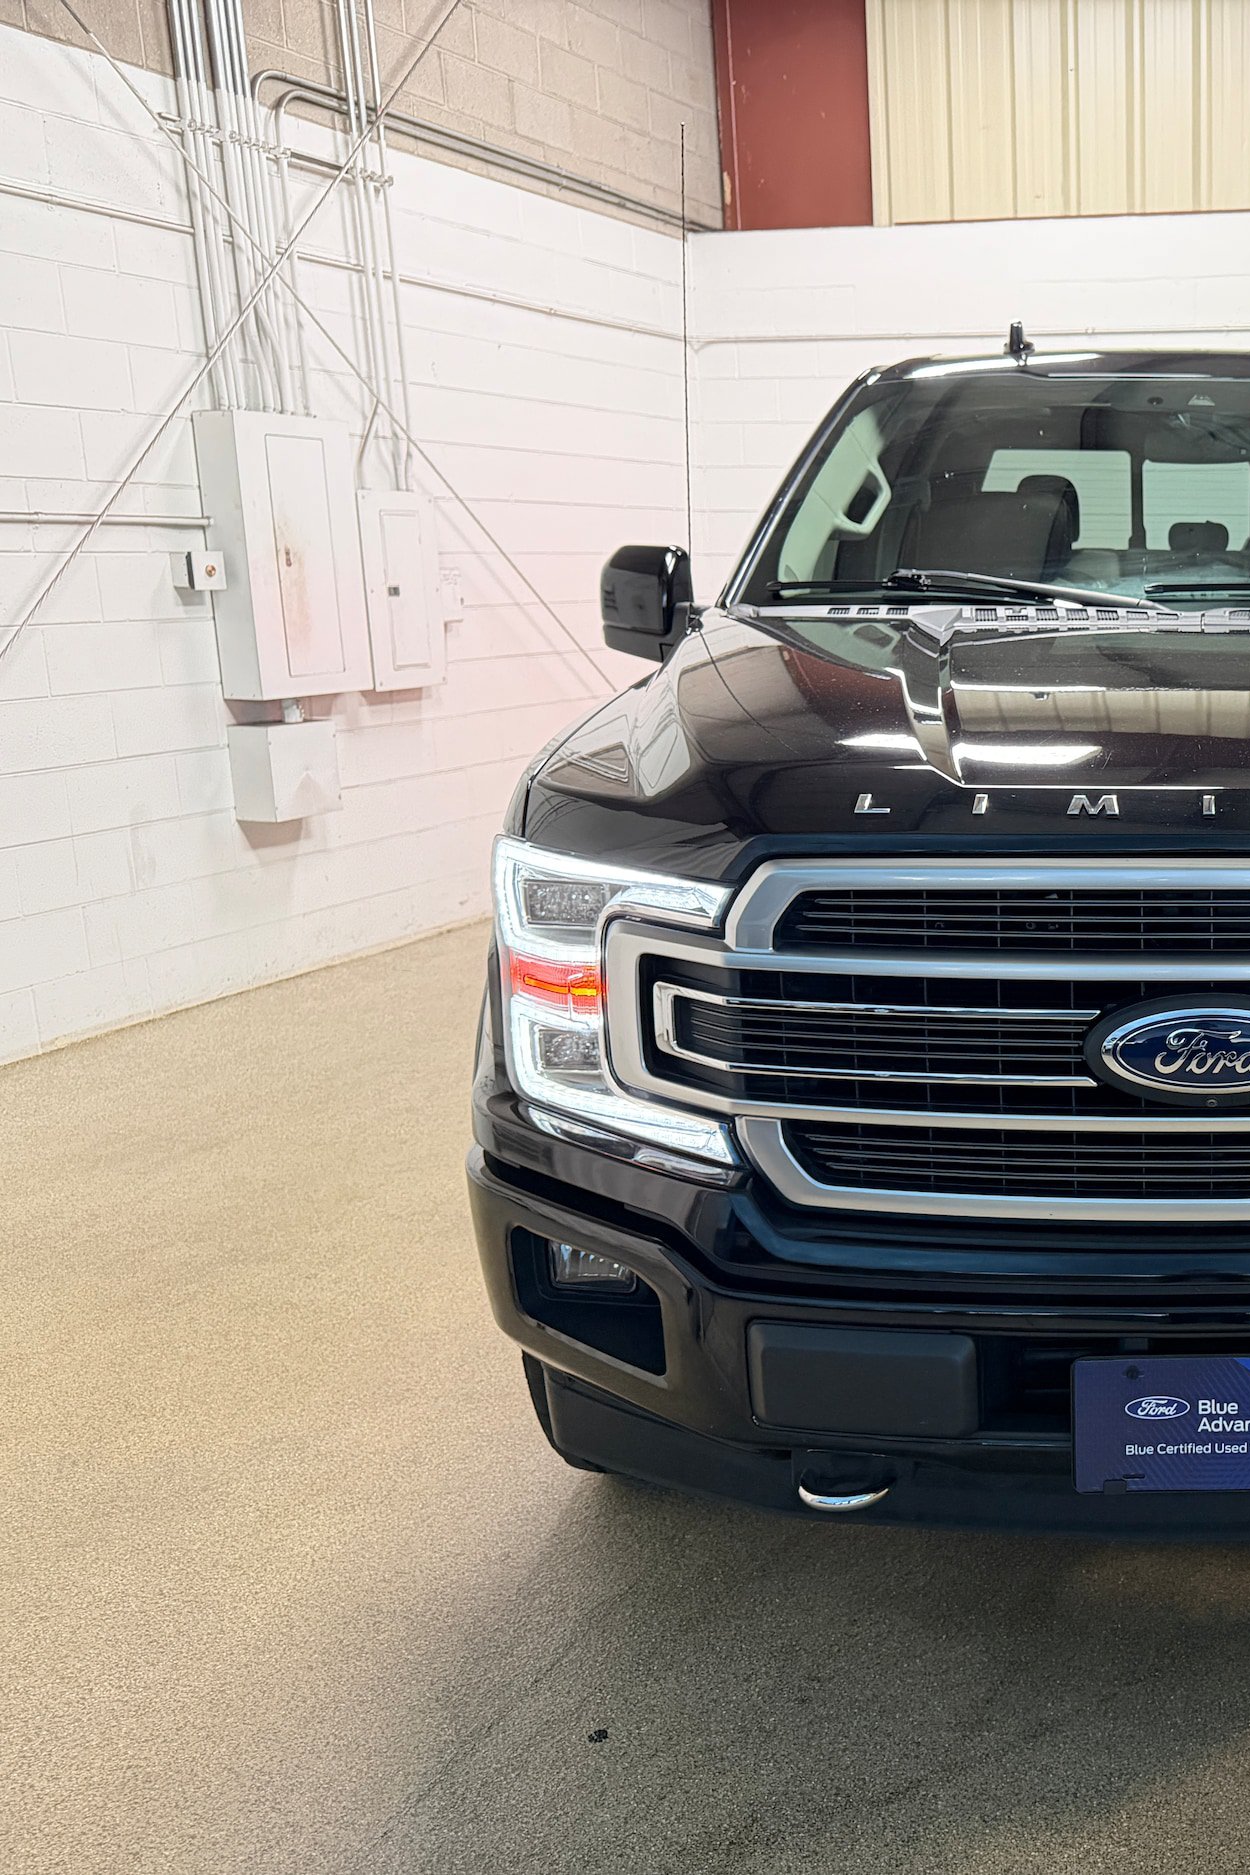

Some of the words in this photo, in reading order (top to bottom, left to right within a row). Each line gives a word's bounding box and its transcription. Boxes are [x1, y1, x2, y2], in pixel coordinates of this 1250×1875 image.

[1137, 1399, 1177, 1416] Ford
[1198, 1399, 1238, 1415] Blue
[1125, 1444, 1154, 1456] Blue
[1156, 1443, 1210, 1455] Certified
[1214, 1442, 1248, 1454] Used
